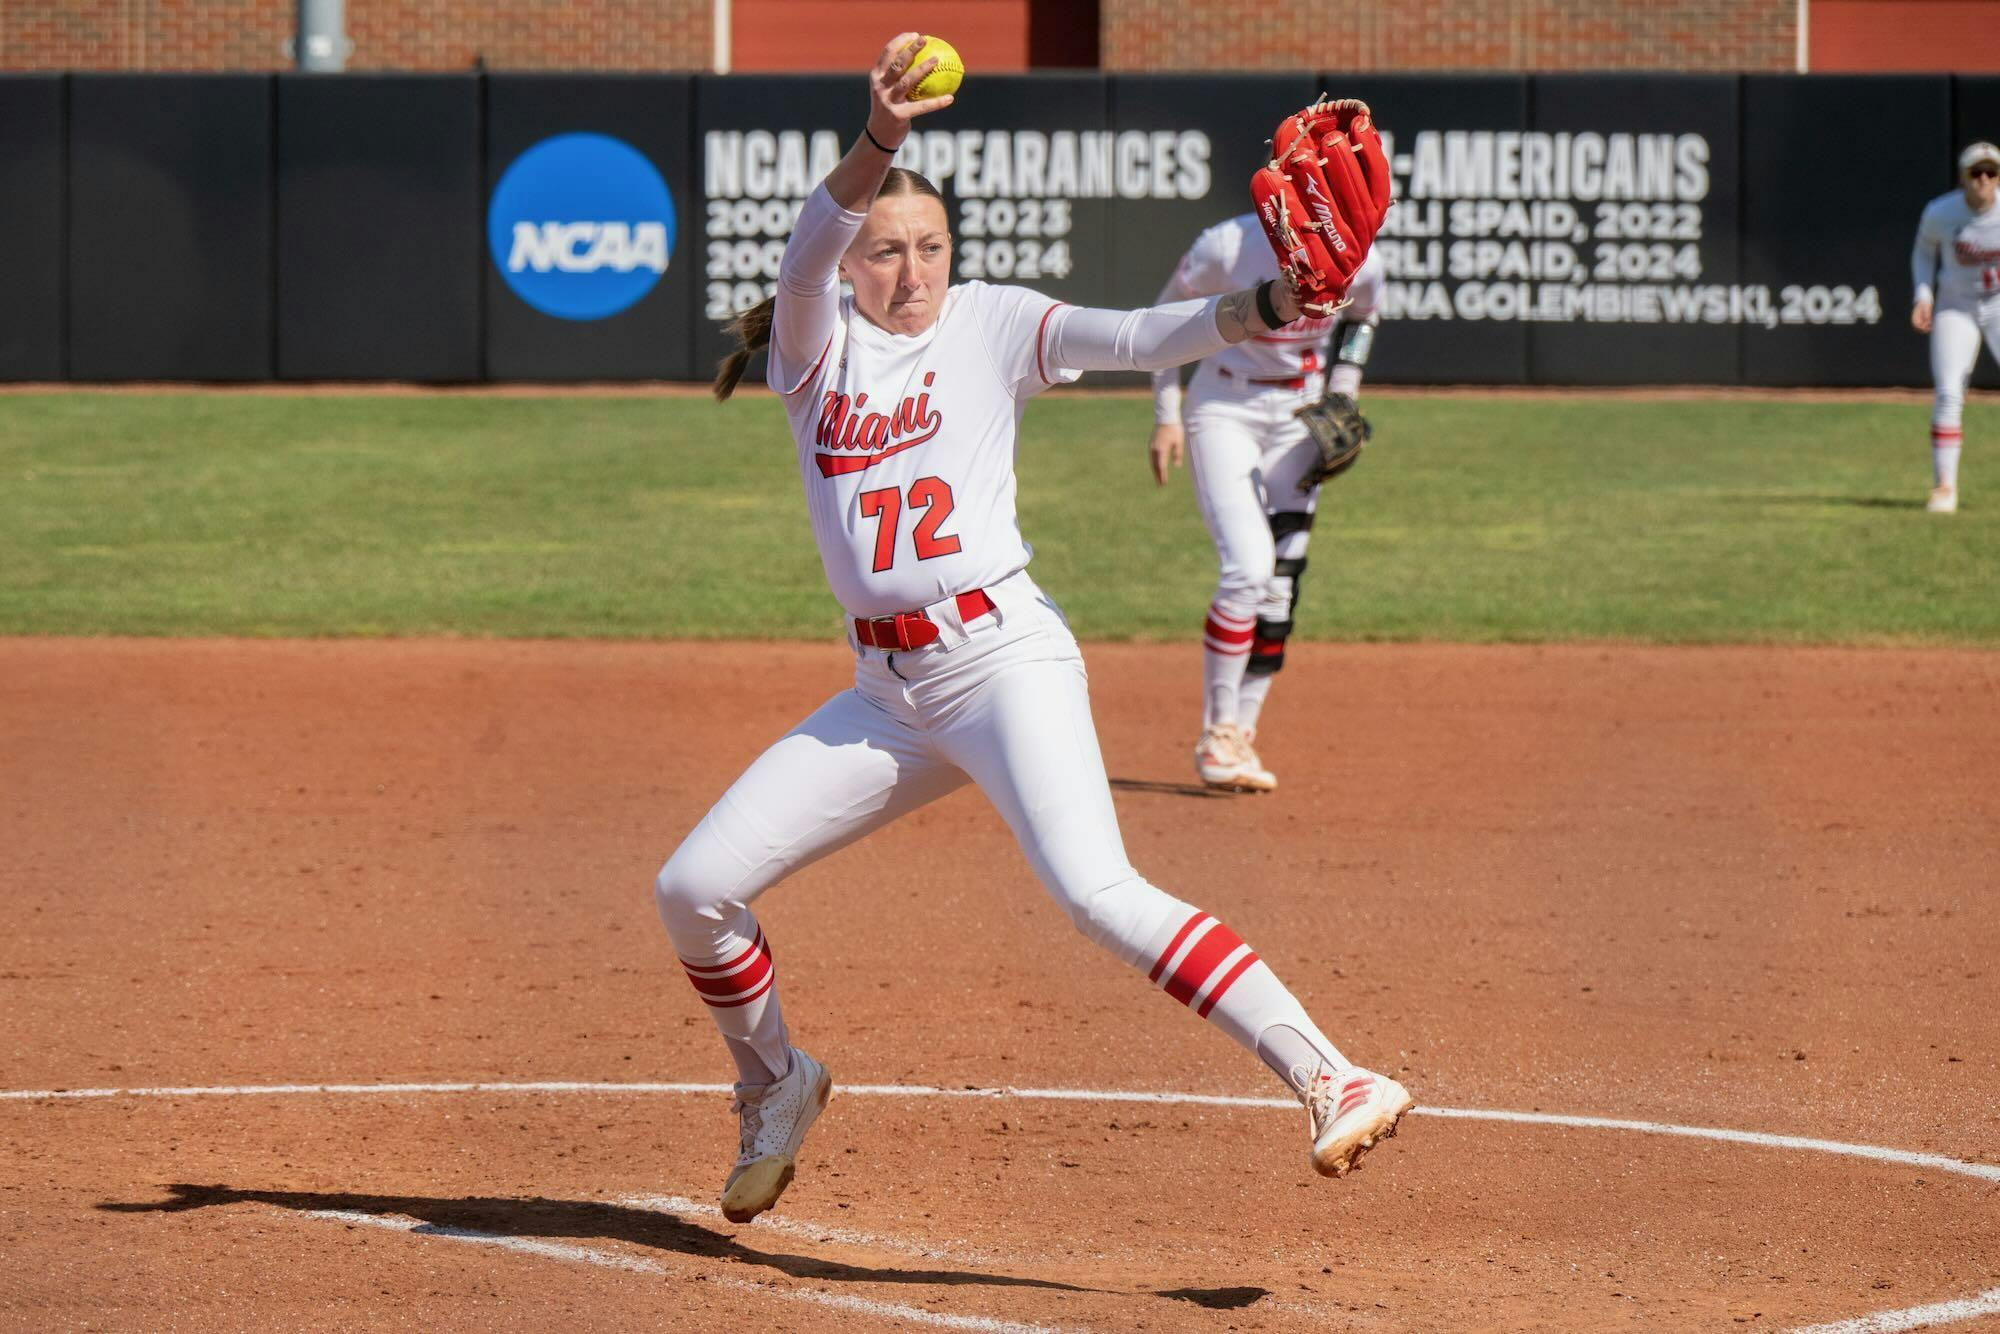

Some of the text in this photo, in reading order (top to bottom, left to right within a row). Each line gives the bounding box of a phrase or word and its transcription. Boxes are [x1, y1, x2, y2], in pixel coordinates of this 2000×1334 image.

[705, 130, 1211, 199] NCAA PPEARANCES
[706, 200, 804, 238] 200
[958, 200, 1072, 237] 2023
[1449, 201, 1588, 243] SPAID,
[1594, 202, 1702, 239] 2022
[508, 221, 669, 274] NCAA
[958, 240, 1072, 279] 2024
[1448, 240, 1587, 284] SPAID,
[1593, 243, 1702, 281] 2024
[859, 475, 962, 573] 72
